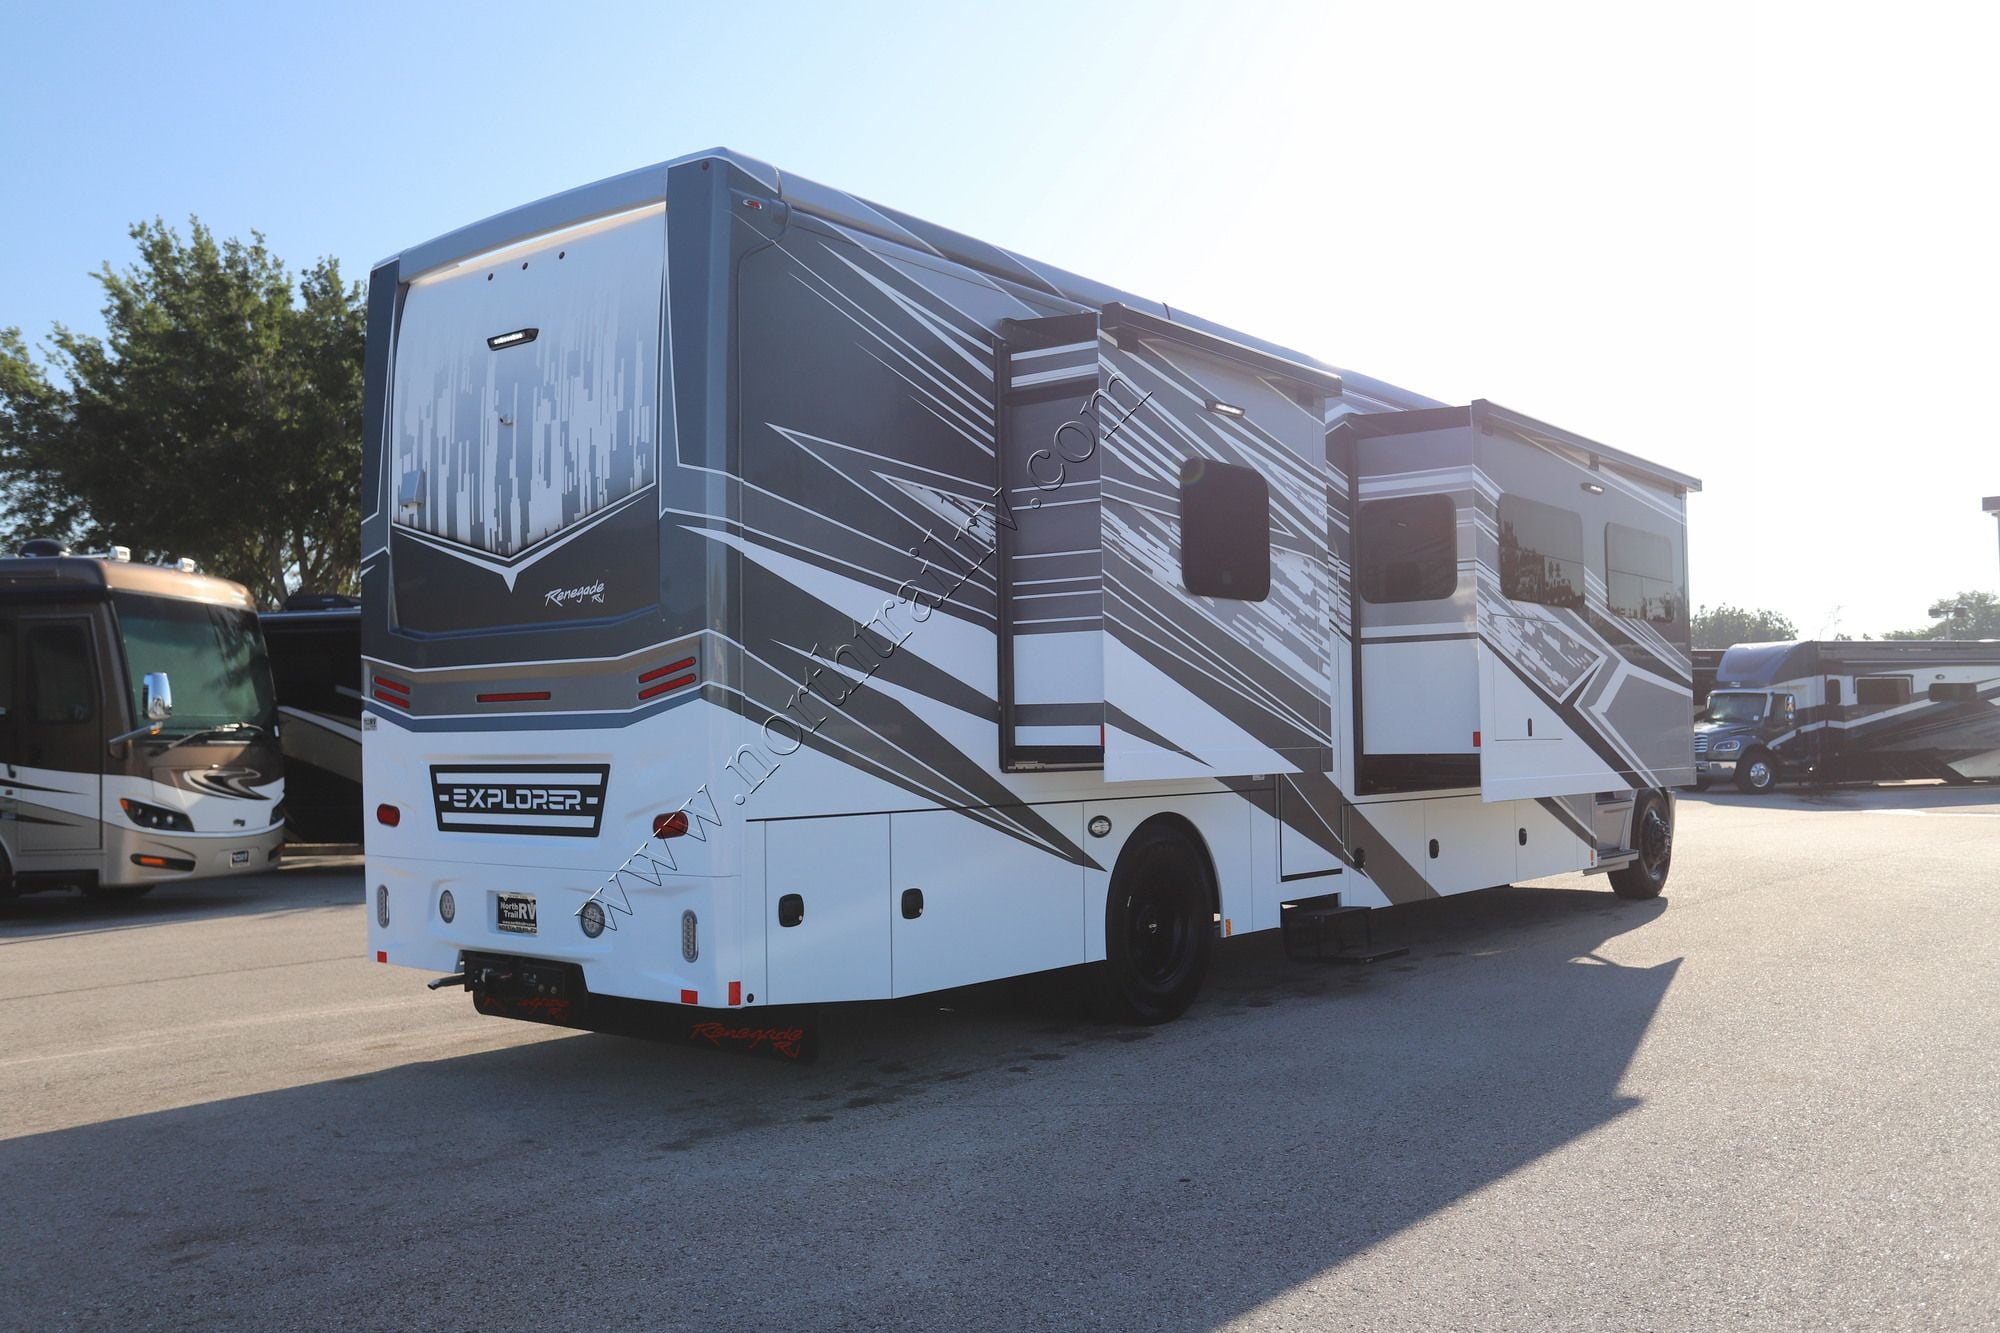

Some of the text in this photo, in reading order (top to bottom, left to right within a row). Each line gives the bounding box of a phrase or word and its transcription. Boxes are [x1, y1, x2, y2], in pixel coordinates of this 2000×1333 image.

[544, 579, 605, 607] Renegade
[591, 593, 605, 604] RV
[453, 788, 582, 811] EXPLORER
[500, 902, 519, 911] North
[503, 910, 519, 919] Trail
[518, 903, 537, 920] RV
[688, 1022, 805, 1050] Renegade
